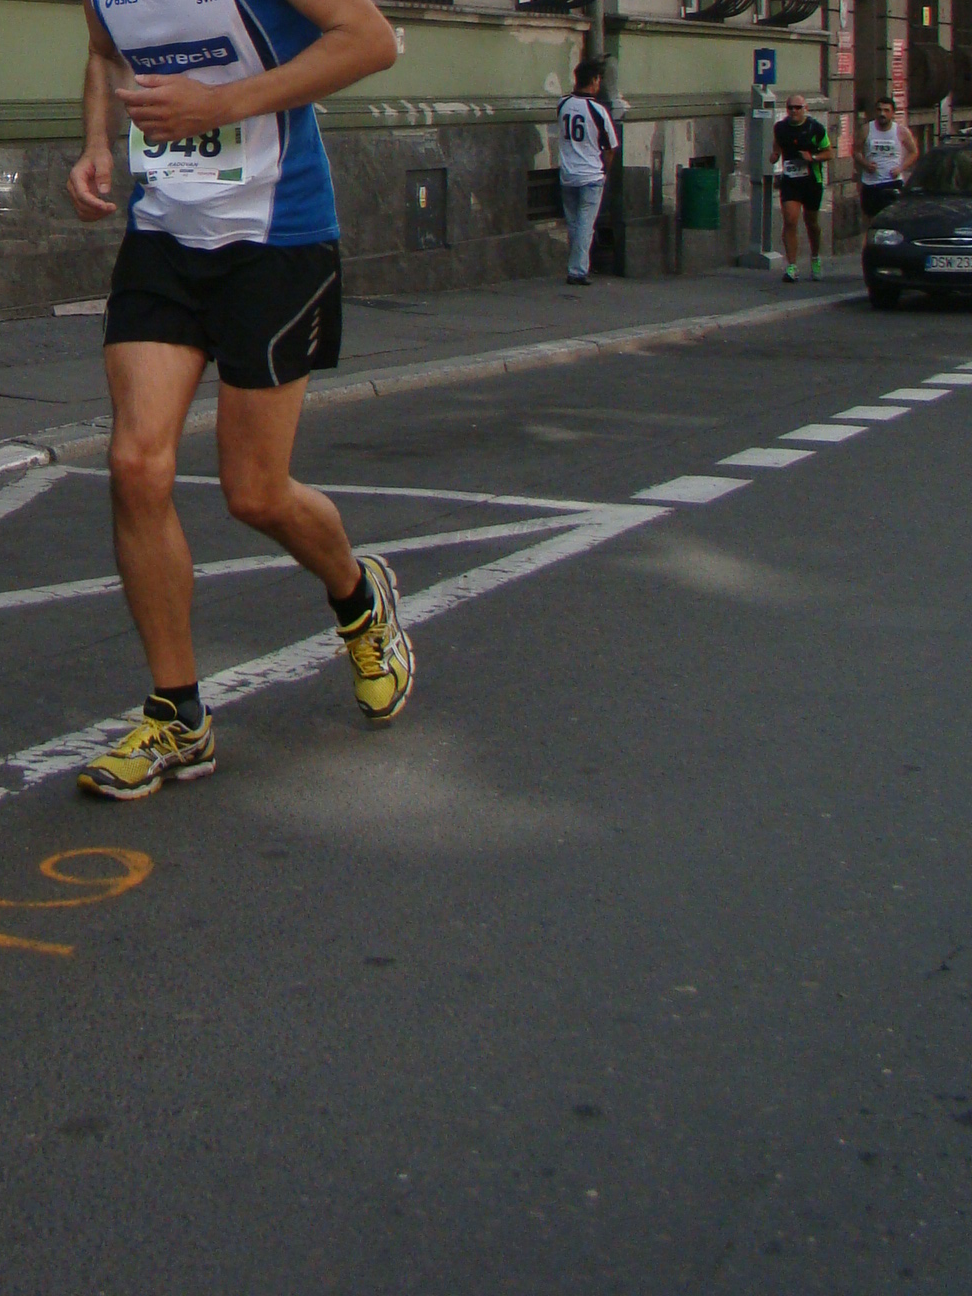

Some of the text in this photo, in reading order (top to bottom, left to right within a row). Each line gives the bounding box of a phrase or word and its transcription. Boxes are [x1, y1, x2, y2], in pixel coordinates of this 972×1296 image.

[131, 47, 228, 68] faurecia
[757, 59, 771, 75] P
[562, 113, 585, 142] 16
[956, 256, 972, 268] 23
